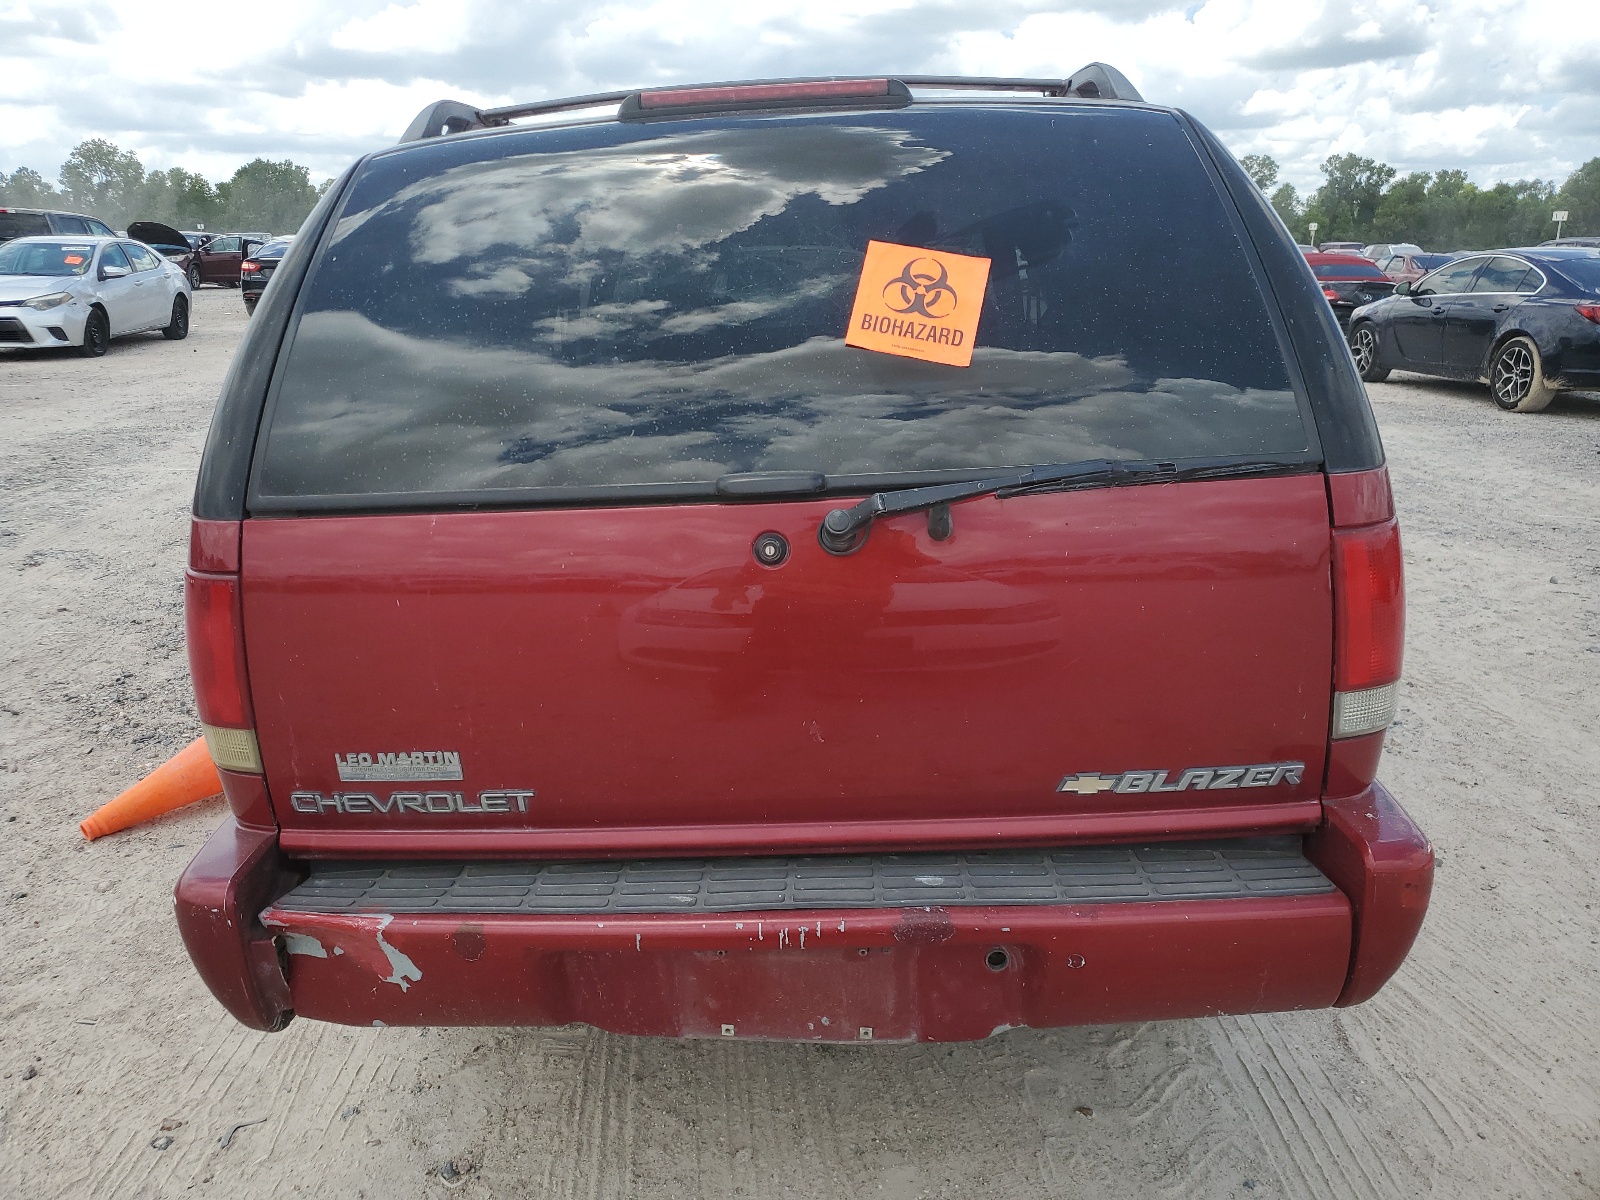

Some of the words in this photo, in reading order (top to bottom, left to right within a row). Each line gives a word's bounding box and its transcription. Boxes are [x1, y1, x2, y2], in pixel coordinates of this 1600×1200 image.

[861, 313, 964, 347] BIOHAZARD
[335, 752, 372, 767] LEO
[377, 751, 460, 767] MARTIN
[1113, 761, 1305, 793] BLAZER
[290, 789, 535, 814] CHEVROLET
